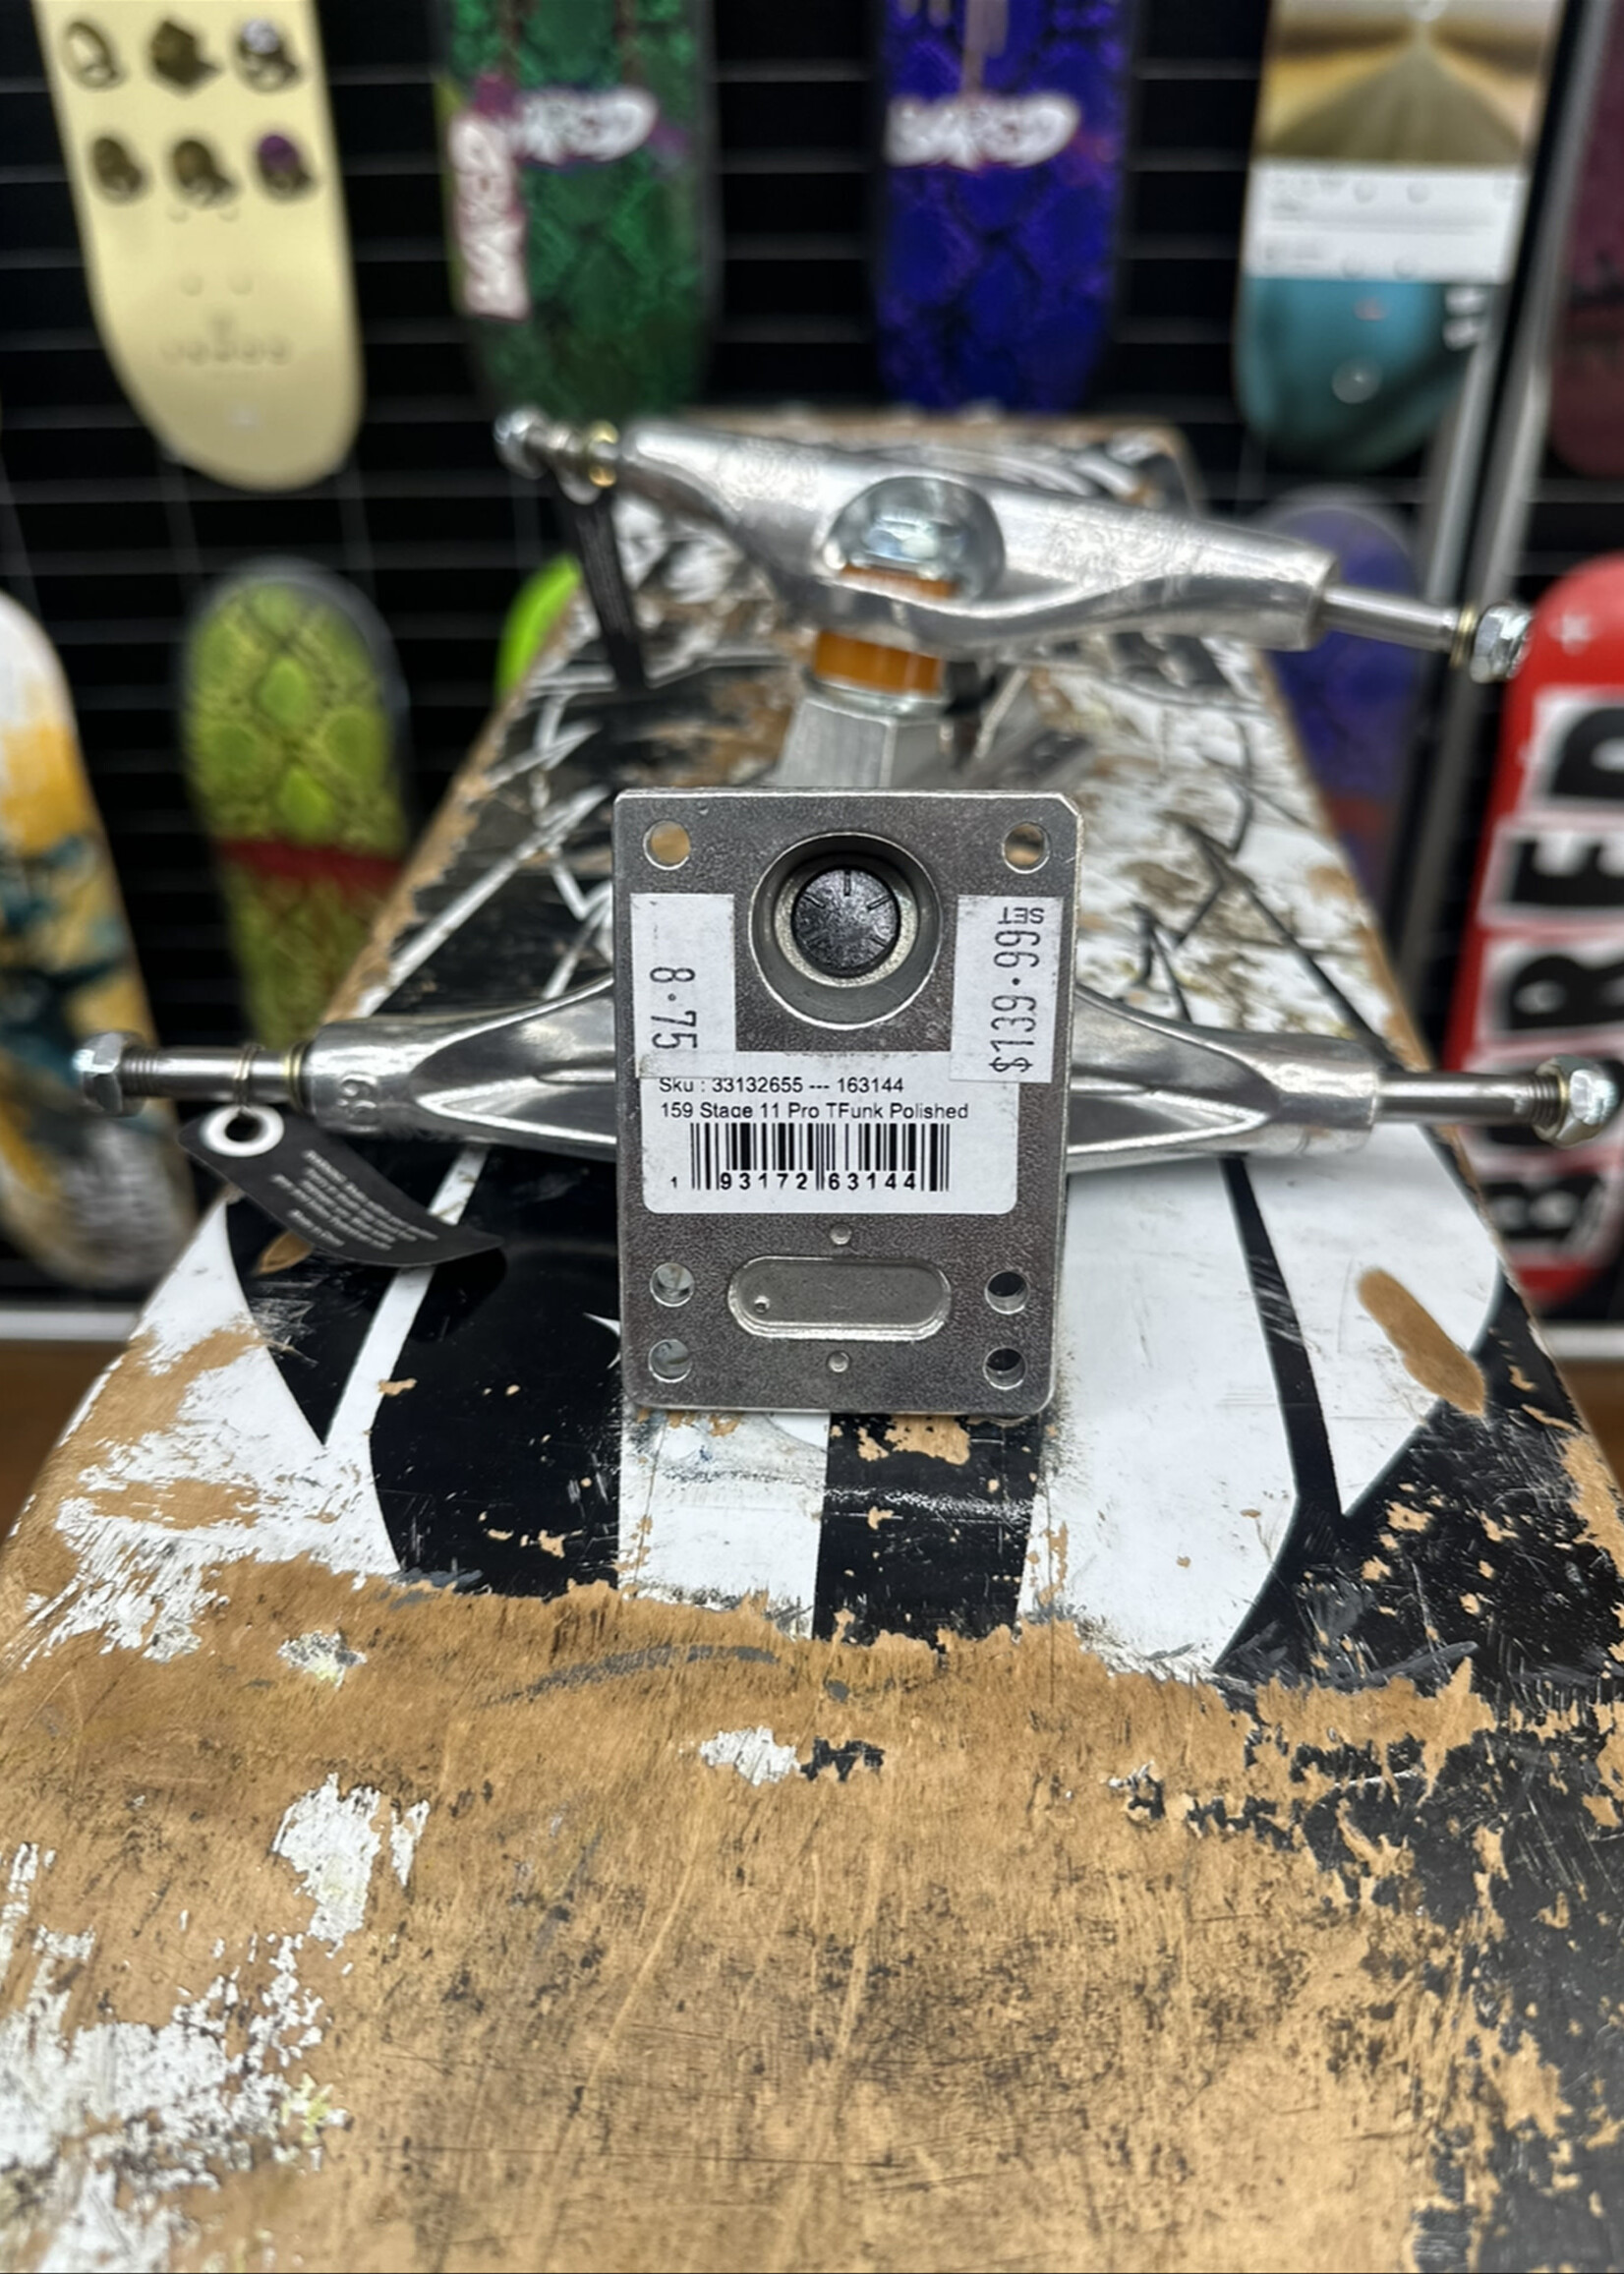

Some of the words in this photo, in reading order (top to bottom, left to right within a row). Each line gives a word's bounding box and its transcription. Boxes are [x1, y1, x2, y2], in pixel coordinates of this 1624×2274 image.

[997, 906, 1045, 925] SET
[650, 966, 698, 1049] 8.75
[988, 930, 1042, 1074] $139.99
[659, 1077, 694, 1093] Sku
[712, 1077, 804, 1093] 33132655
[837, 1077, 904, 1093] 163144
[661, 1101, 694, 1119] 159
[760, 1101, 780, 1119] 11
[787, 1101, 820, 1119] Pro
[826, 1101, 884, 1120] TFunk
[889, 1101, 969, 1120] Polished
